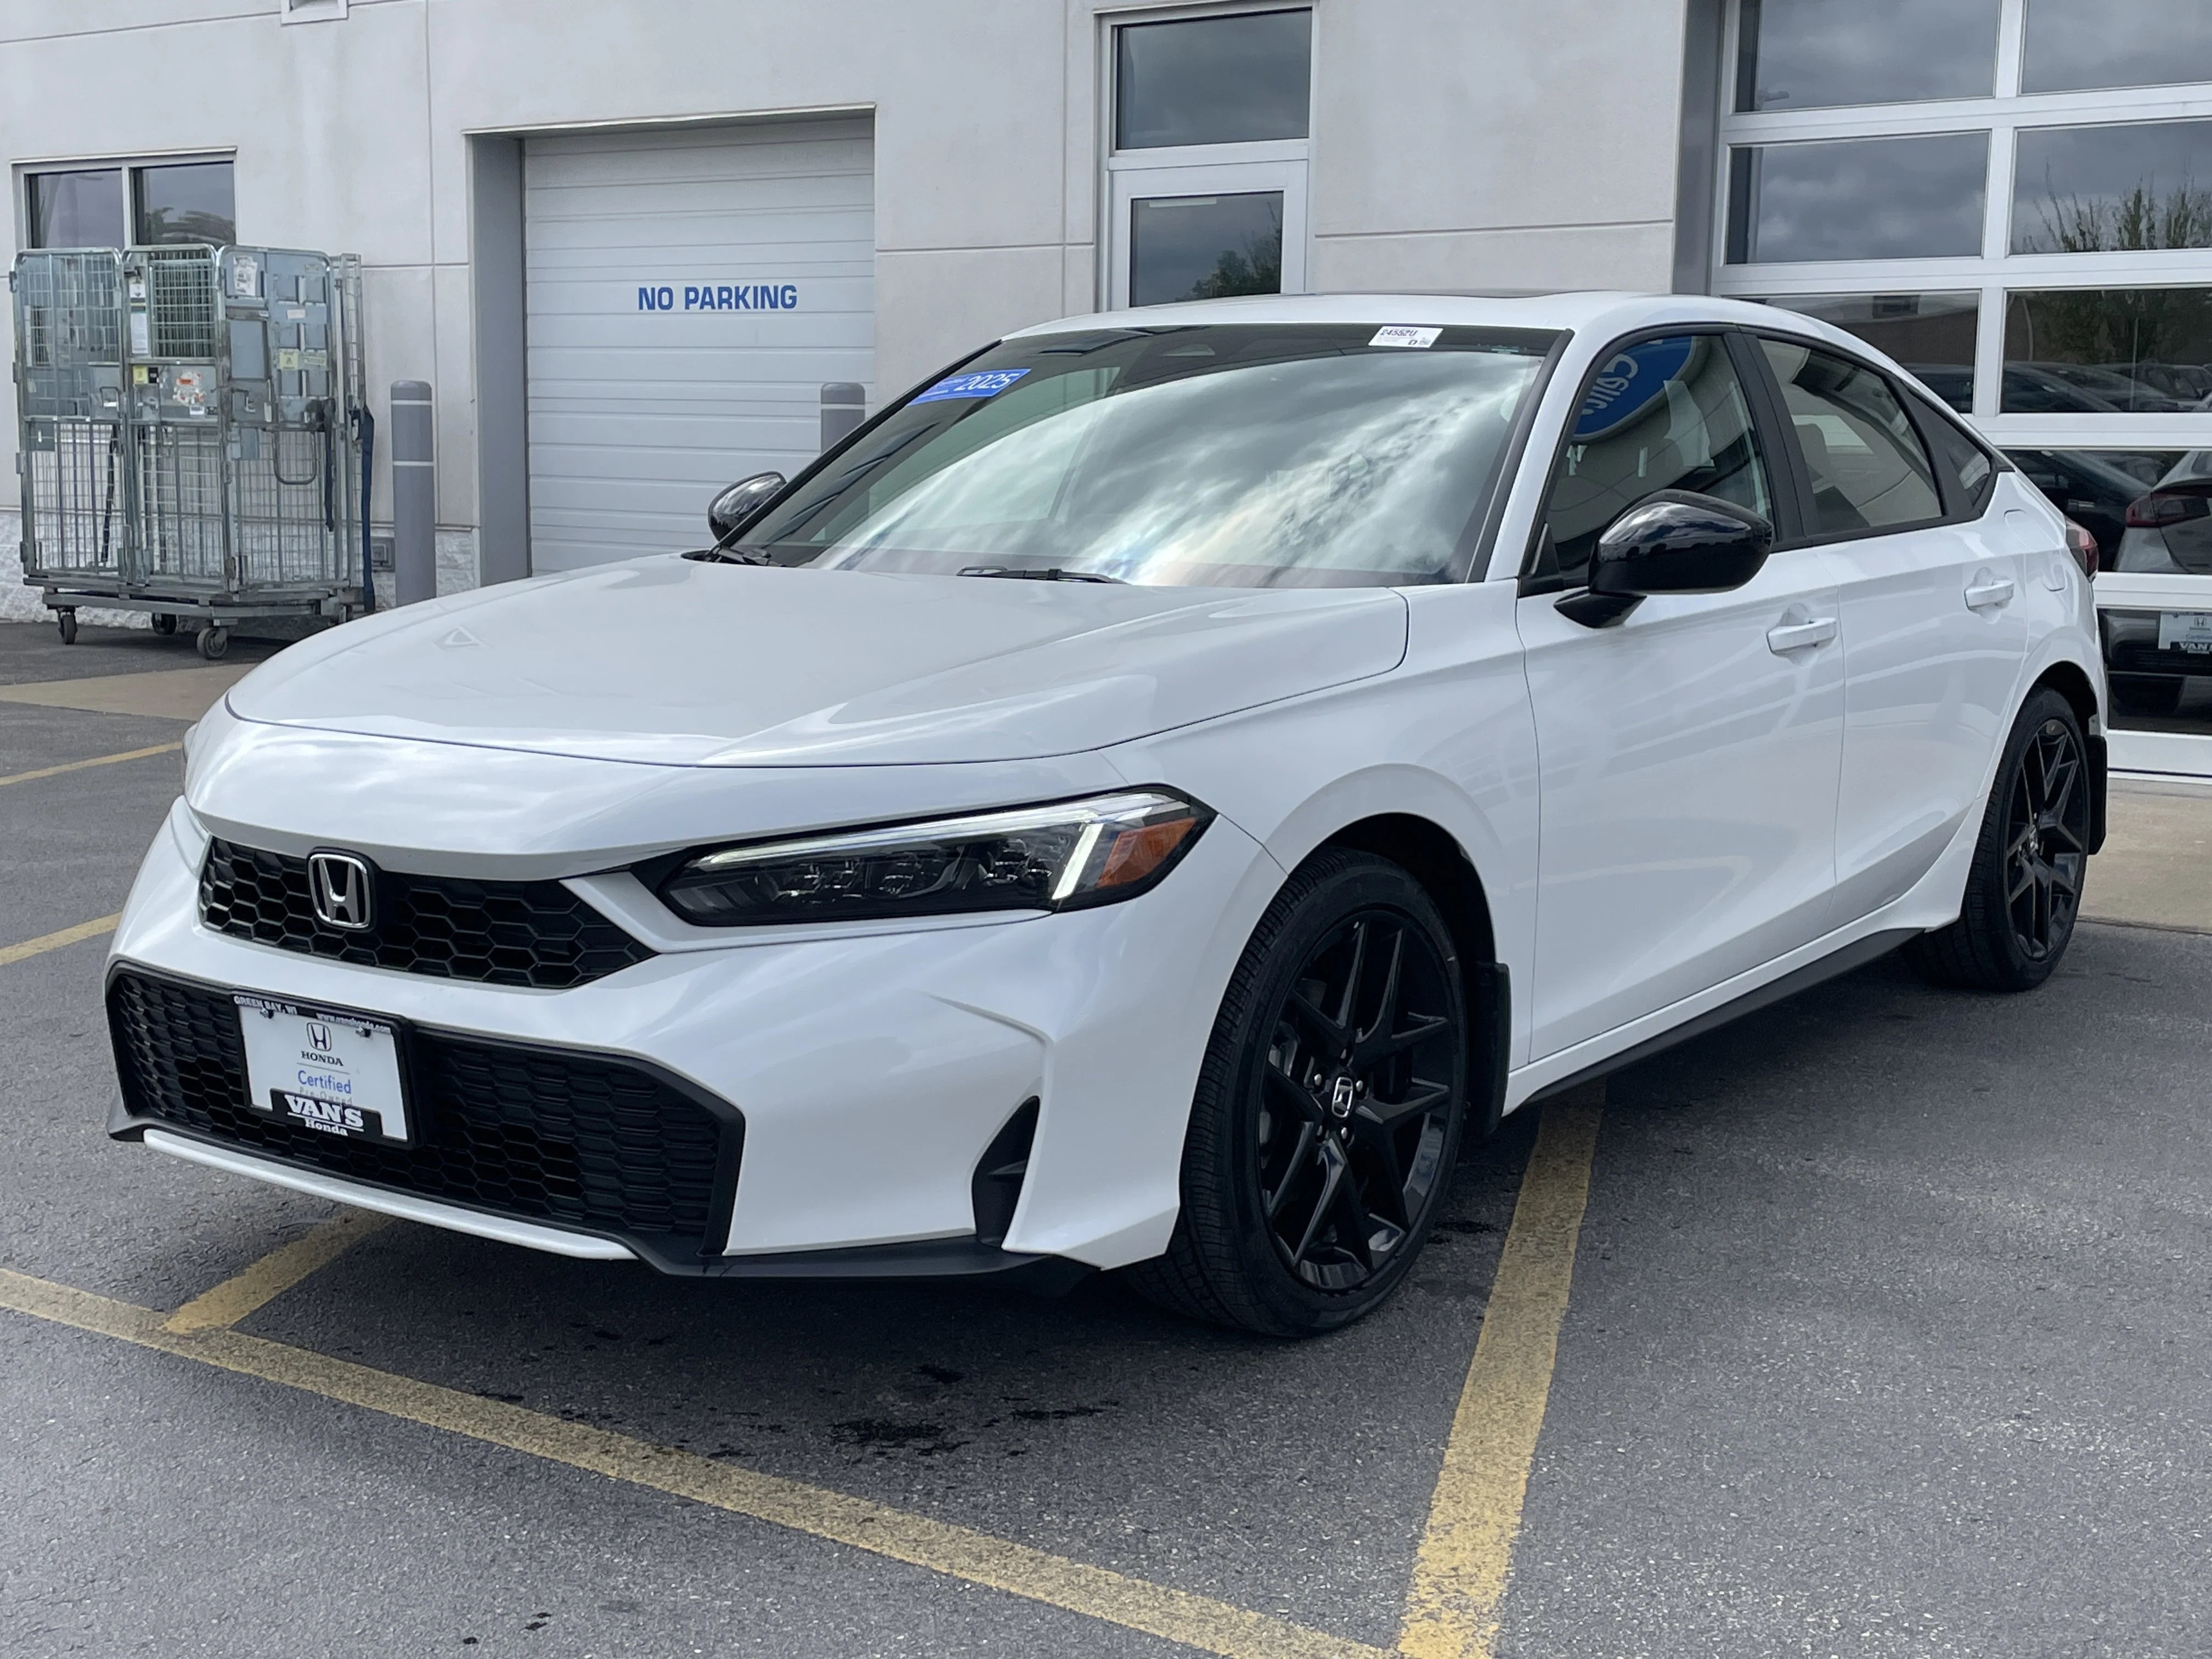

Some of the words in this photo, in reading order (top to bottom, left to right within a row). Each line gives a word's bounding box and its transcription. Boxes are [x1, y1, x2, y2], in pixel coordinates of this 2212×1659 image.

[638, 286, 674, 311] NO
[684, 285, 797, 311] PARKING
[953, 373, 1020, 391] 2025
[301, 1051, 344, 1066] HONDA
[297, 1069, 352, 1094] Certified
[299, 1086, 352, 1105] Pre-Owned
[304, 1118, 348, 1137] Honda
